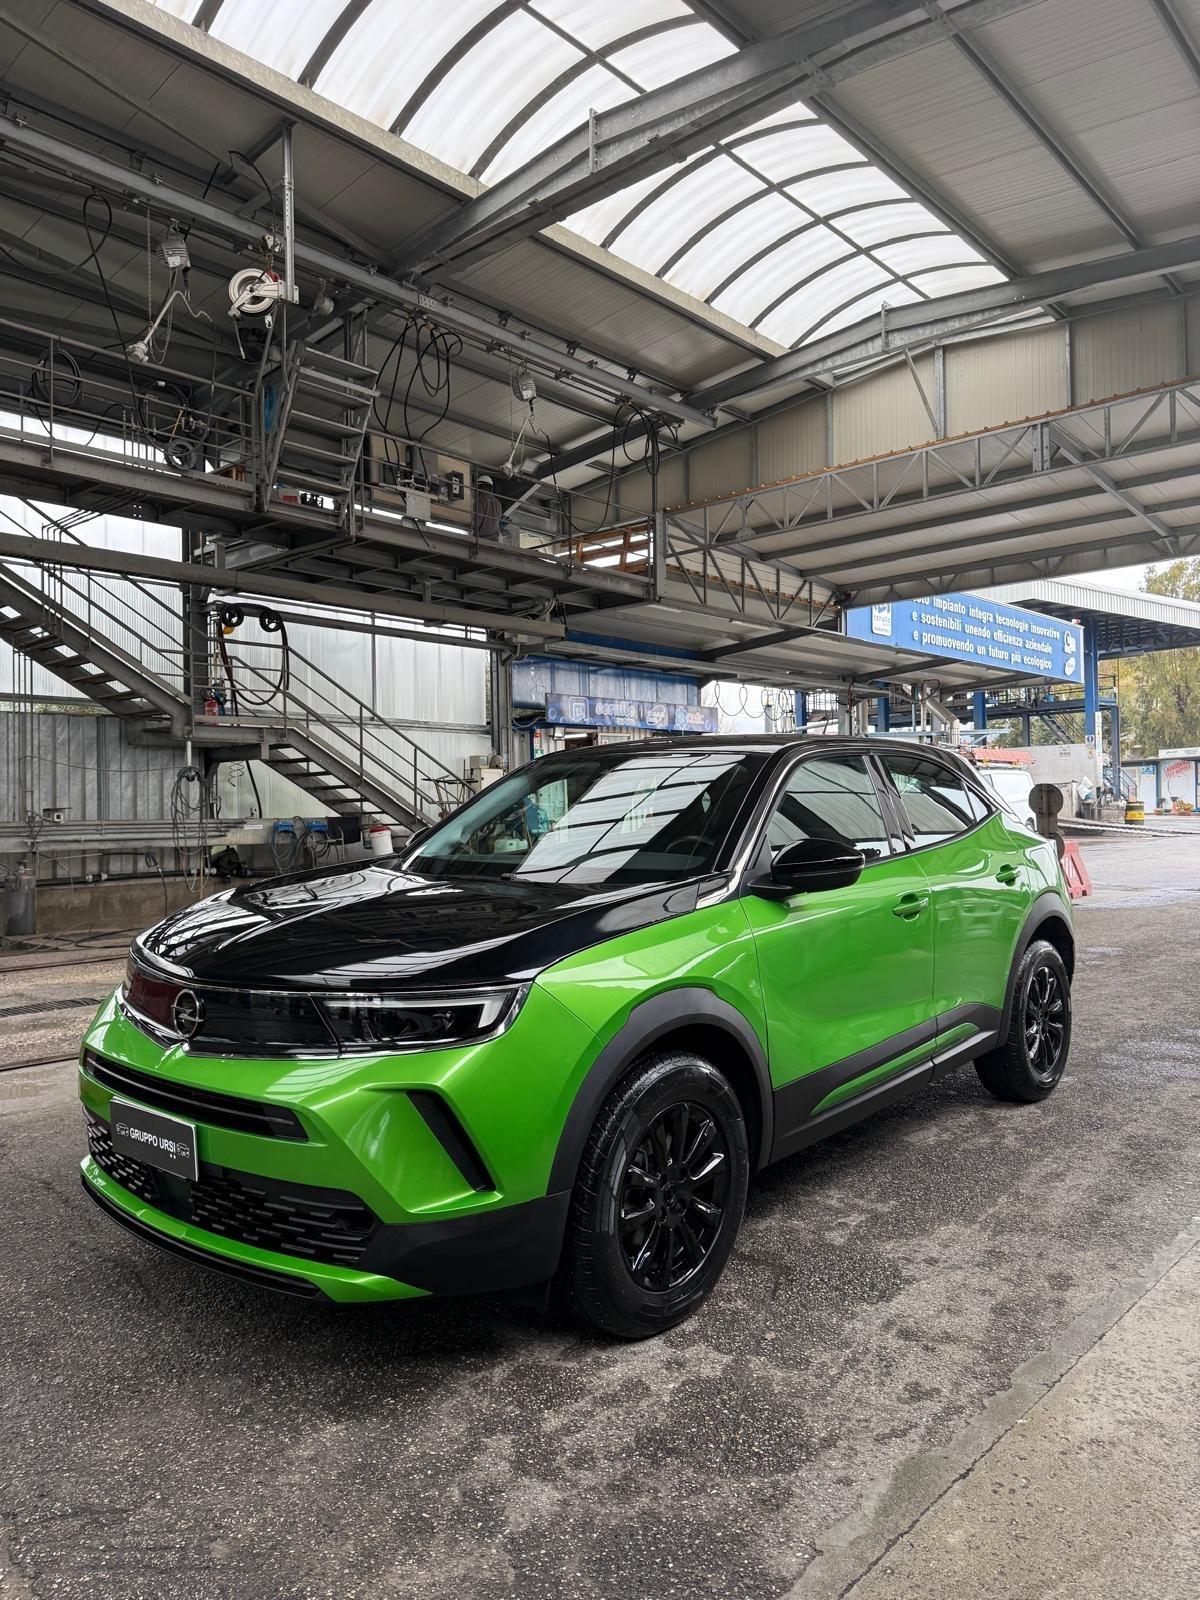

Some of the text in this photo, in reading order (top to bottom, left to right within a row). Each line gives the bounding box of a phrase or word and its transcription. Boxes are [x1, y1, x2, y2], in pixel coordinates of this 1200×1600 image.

[911, 611, 1053, 655] e sostenibili unendo efficienza aziendale
[933, 597, 966, 614] impianto
[969, 604, 994, 624] integra
[995, 613, 1029, 633] tecnologie
[1030, 622, 1061, 640] innovative
[913, 630, 1053, 671] e promuovendo un futuro più ecologico
[129, 1127, 176, 1153] GRUPPO URSI
